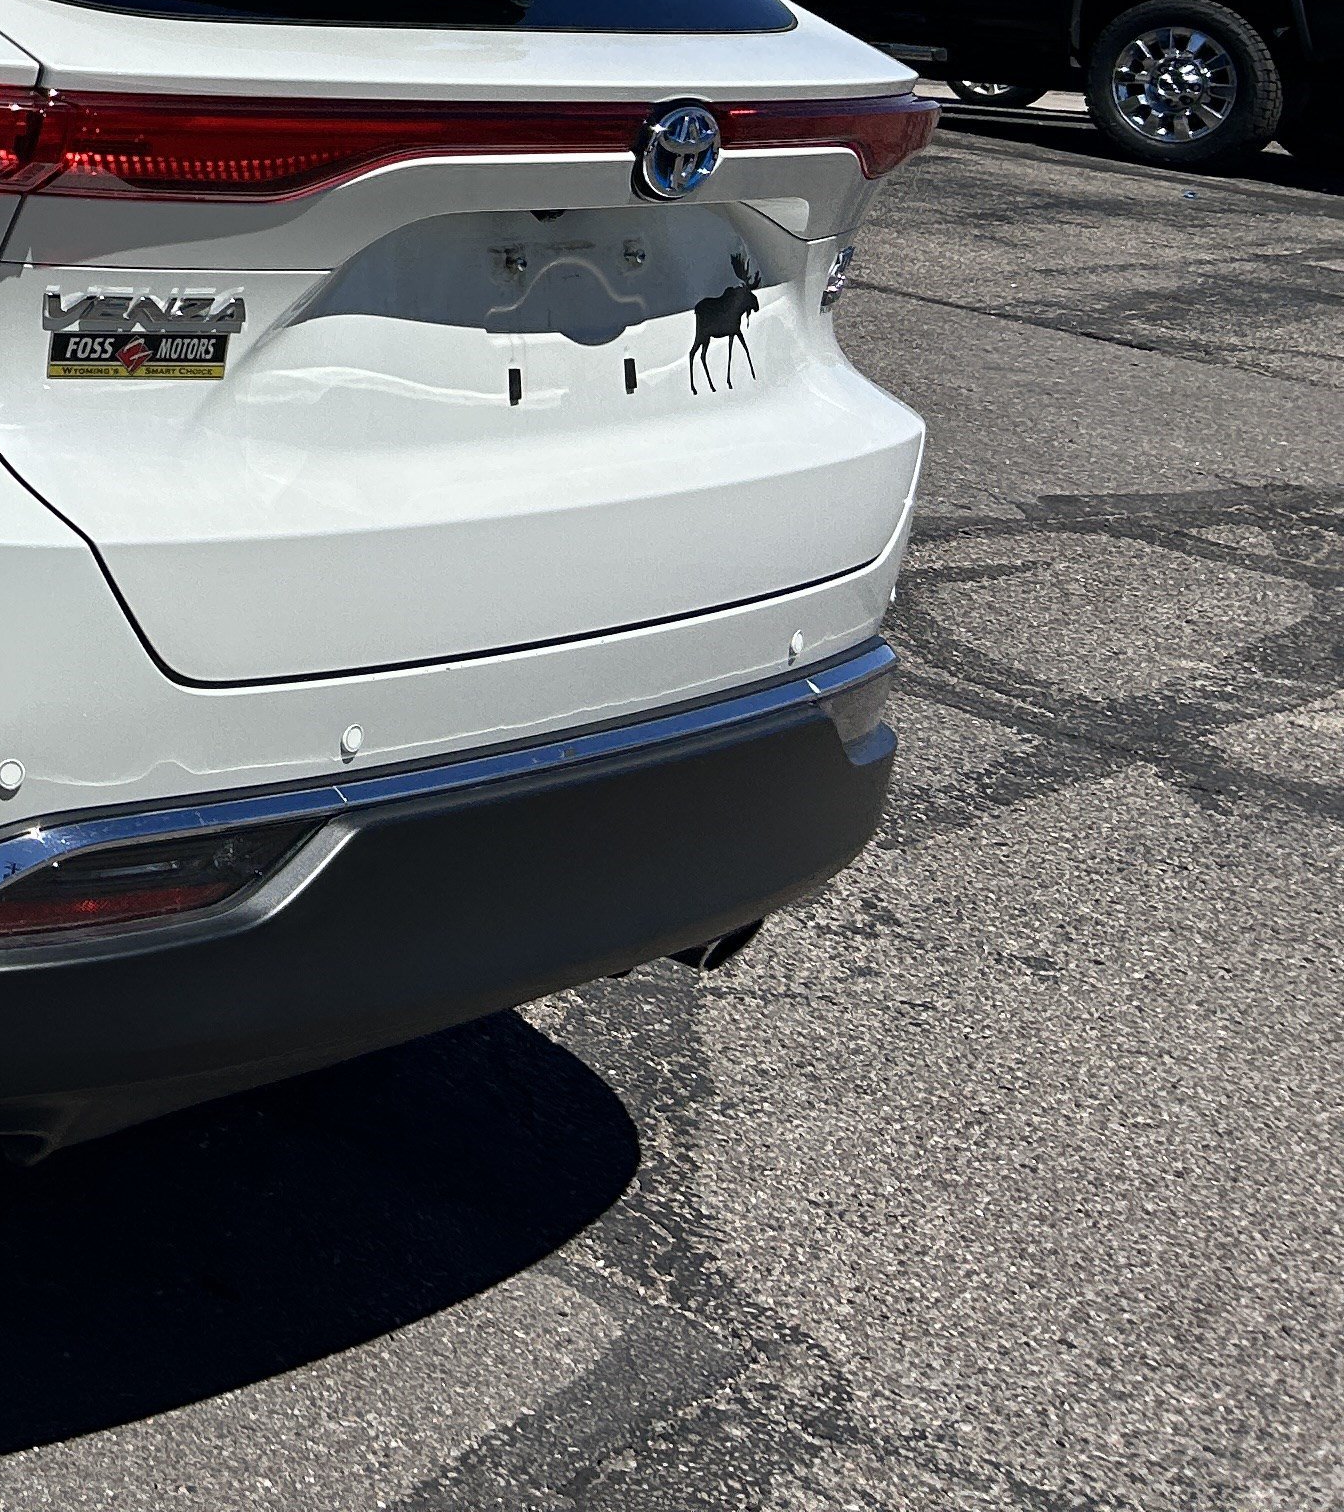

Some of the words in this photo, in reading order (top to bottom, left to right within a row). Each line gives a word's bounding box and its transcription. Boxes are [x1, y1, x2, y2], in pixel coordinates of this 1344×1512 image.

[42, 285, 246, 333] VENZA
[65, 337, 115, 359] FOSS
[156, 337, 216, 360] MOTORS
[144, 366, 177, 376] SMART
[178, 366, 214, 376] CHOICE
